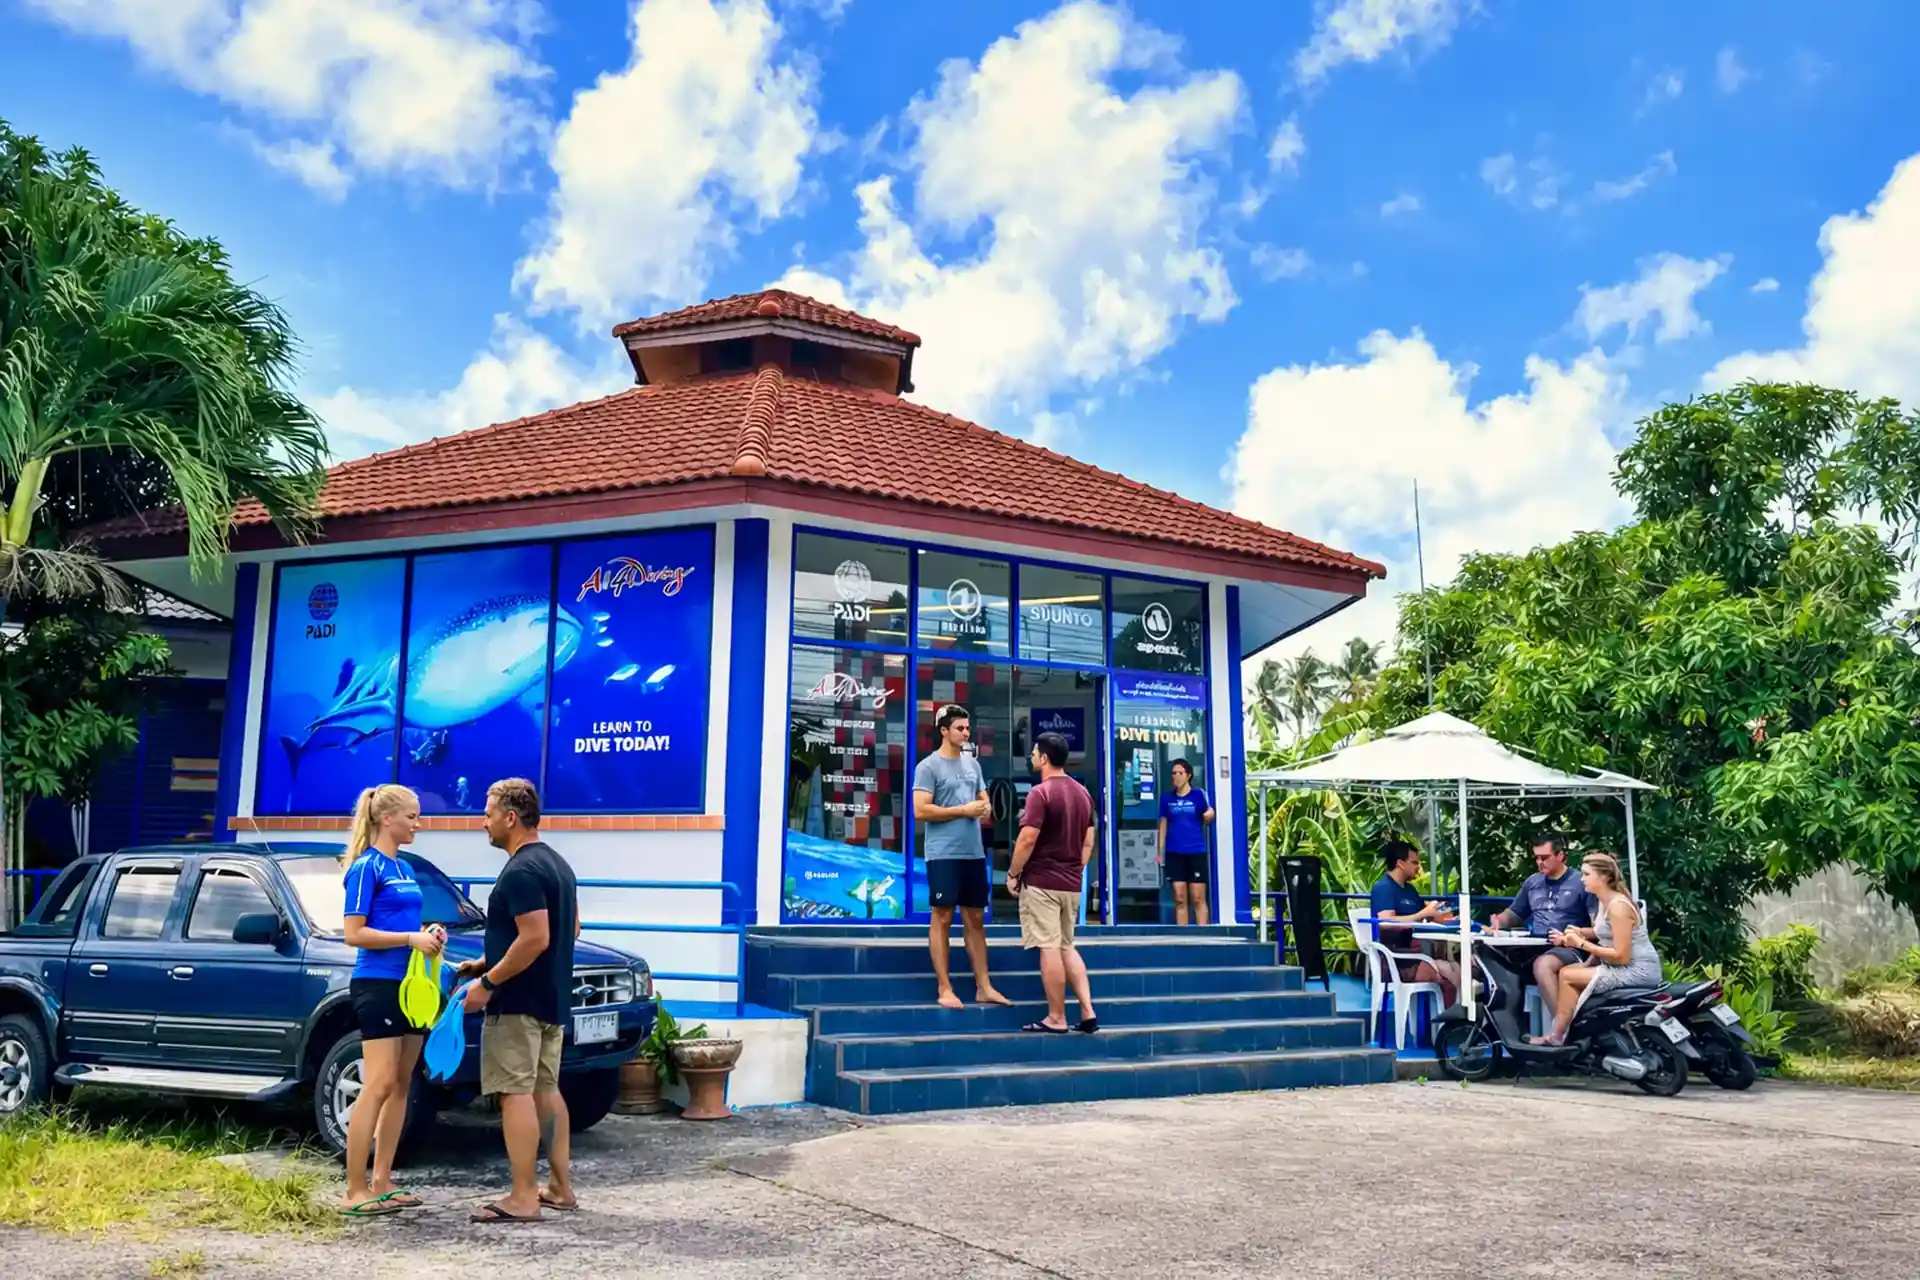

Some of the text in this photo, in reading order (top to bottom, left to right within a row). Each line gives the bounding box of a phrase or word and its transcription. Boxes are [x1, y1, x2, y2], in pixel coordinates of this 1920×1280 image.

[834, 602, 872, 621] PADI
[1029, 605, 1093, 628] SUUNTO
[305, 623, 336, 640] PADI
[592, 720, 652, 735] LEARN TO
[1119, 726, 1151, 743] DIVE
[574, 735, 670, 754] DIVE TODAY!
